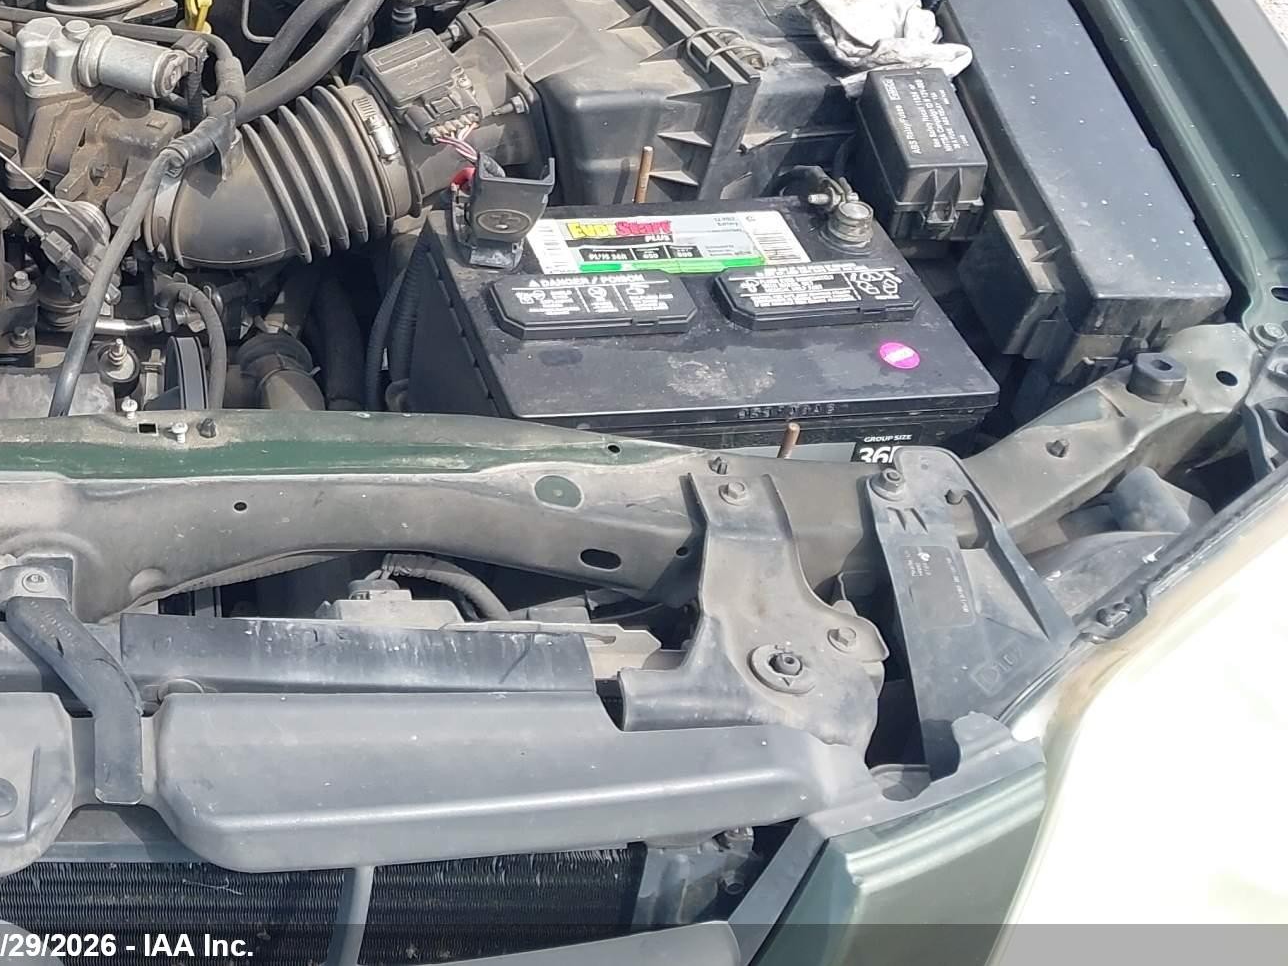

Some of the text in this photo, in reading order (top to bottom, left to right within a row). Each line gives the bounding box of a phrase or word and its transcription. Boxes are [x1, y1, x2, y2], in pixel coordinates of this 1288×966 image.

[541, 277, 590, 287] DANGER
[864, 434, 912, 443] GROUP SIZE
